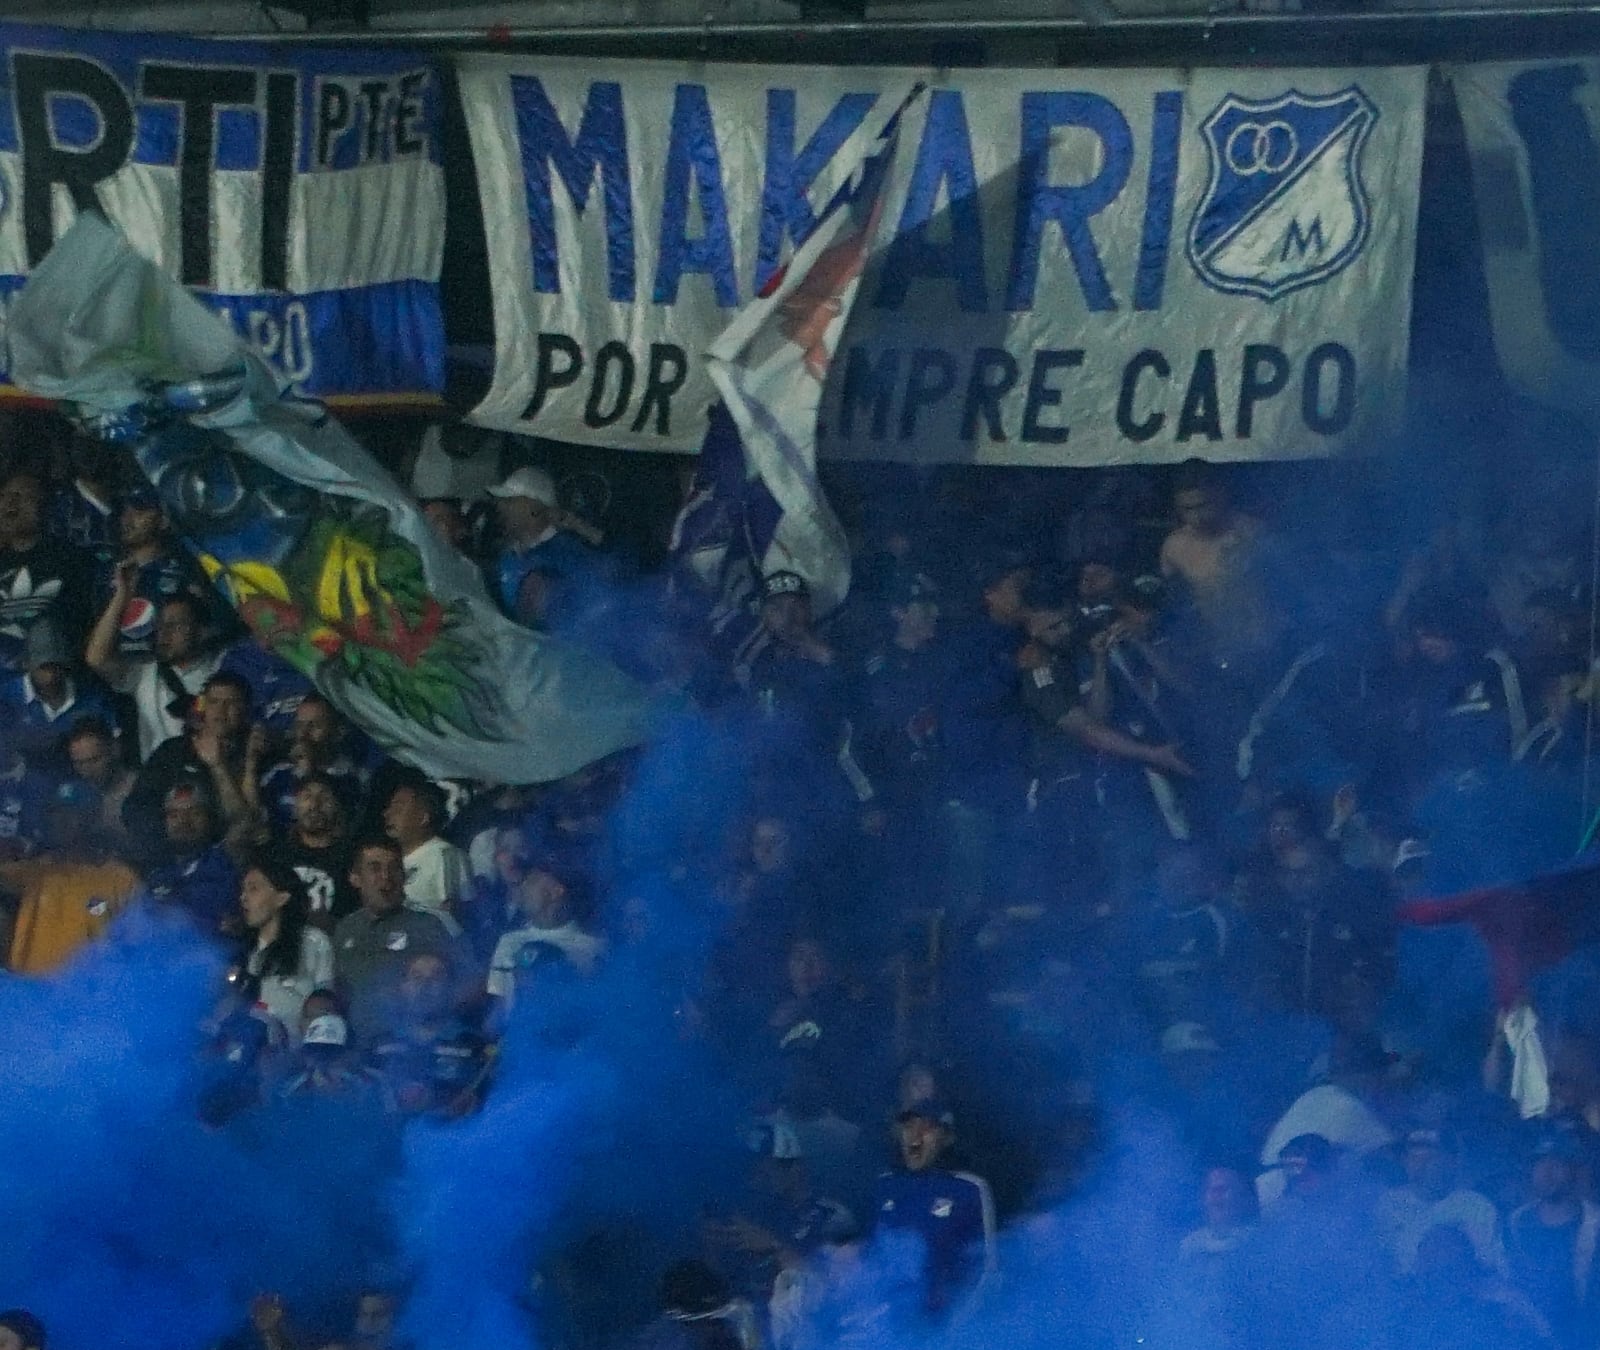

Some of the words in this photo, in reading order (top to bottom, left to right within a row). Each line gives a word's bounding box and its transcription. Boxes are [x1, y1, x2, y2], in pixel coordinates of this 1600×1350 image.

[315, 72, 430, 165] PTE
[510, 75, 1186, 313] MAKARI
[523, 333, 690, 437] POR
[1117, 343, 1357, 443] CAPO
